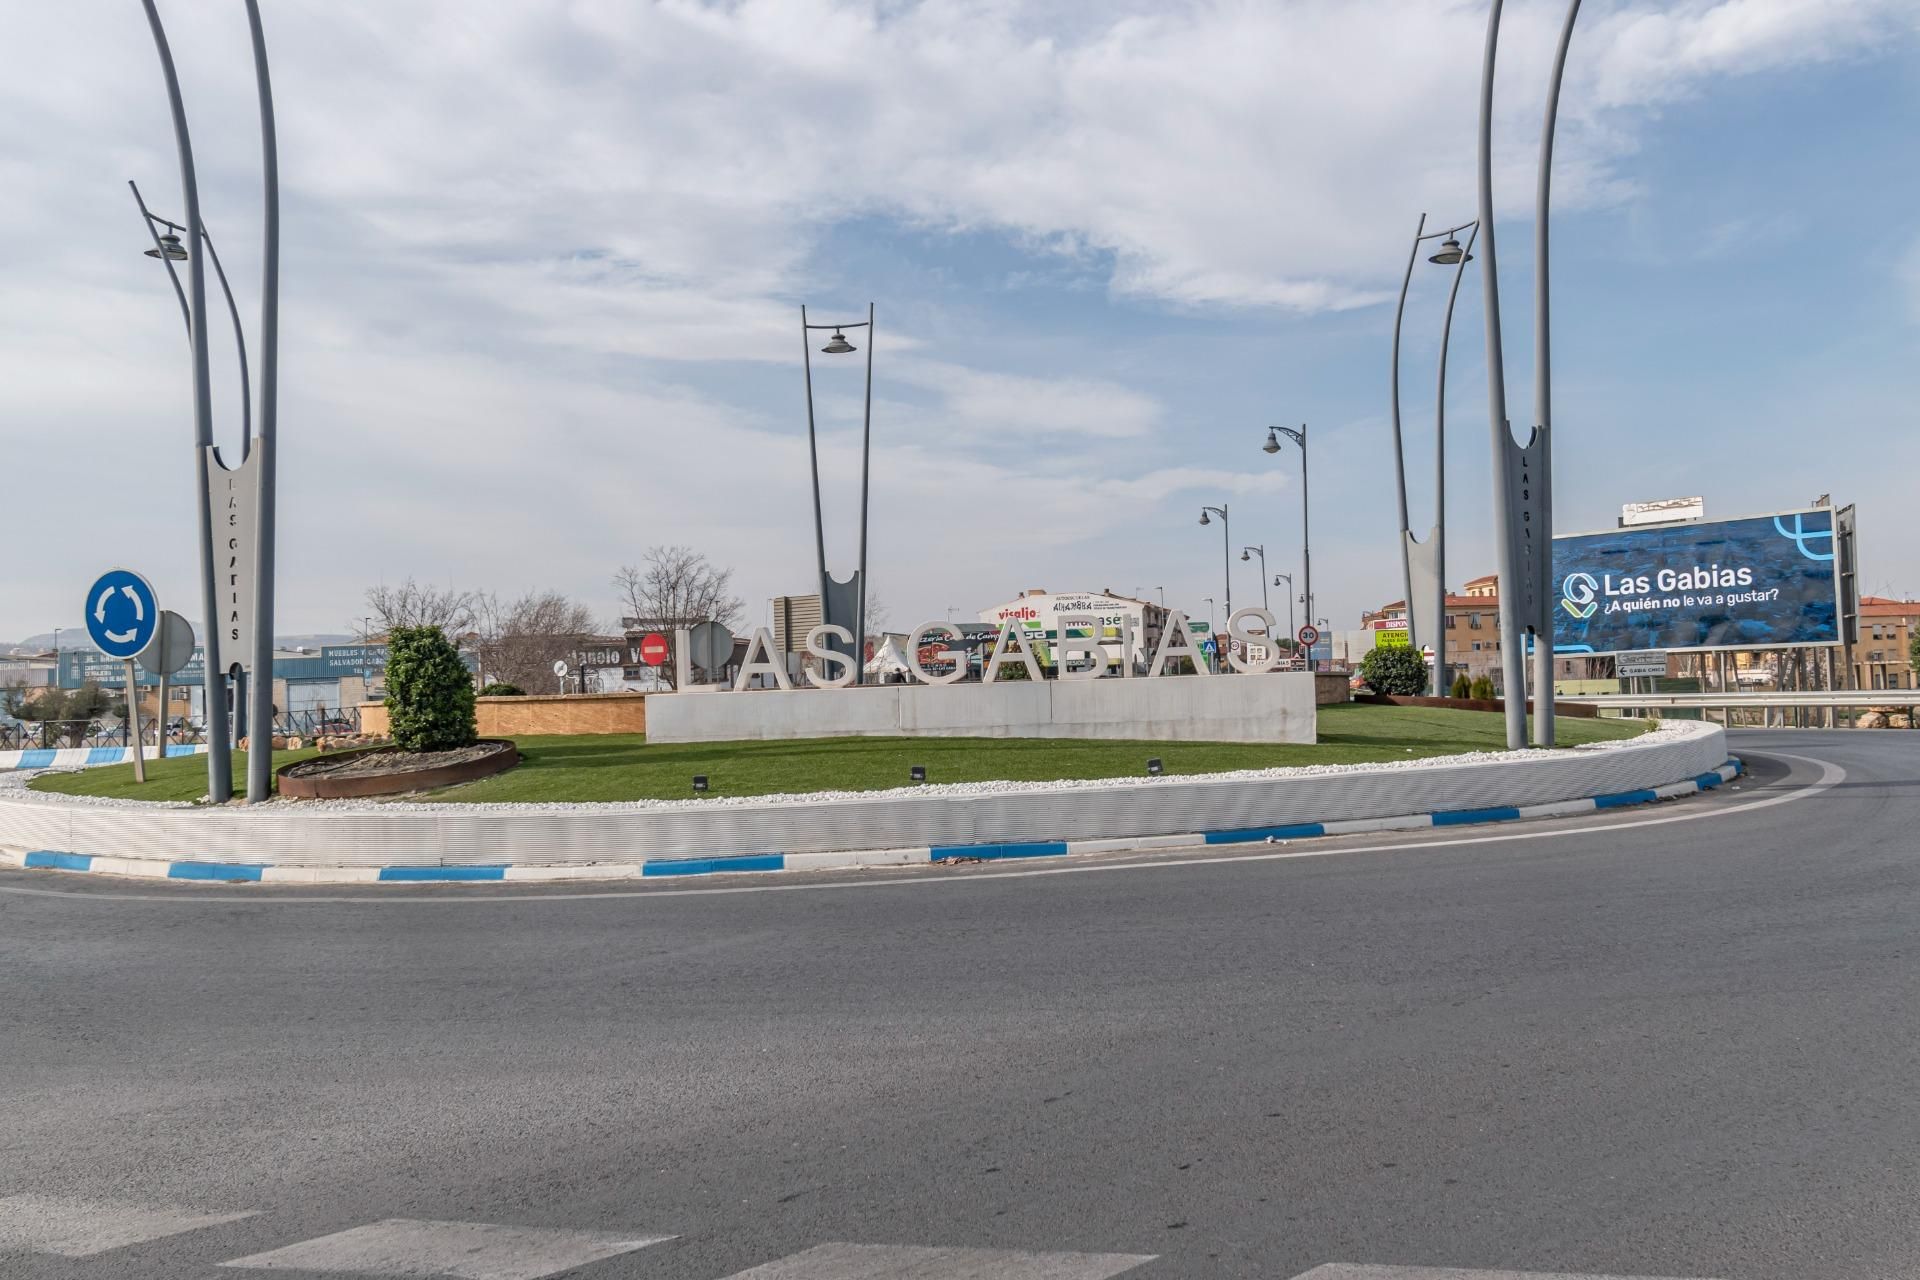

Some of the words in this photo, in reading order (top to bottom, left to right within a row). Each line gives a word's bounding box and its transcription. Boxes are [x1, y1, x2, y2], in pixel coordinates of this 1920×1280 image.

[1604, 574, 1650, 596] Las
[1657, 564, 1752, 592] Gabias
[1604, 601, 1621, 615] ¿A
[1622, 597, 1660, 613] quién
[1663, 598, 1681, 608] no
[1683, 595, 1694, 607] le
[1697, 596, 1712, 606] va
[1715, 595, 1724, 605] a
[1727, 588, 1779, 607] gustar?
[1385, 620, 1408, 629] DISPON
[977, 632, 1000, 641] Camp
[675, 624, 857, 693] LAS
[907, 607, 1280, 685] GABIAS
[329, 659, 363, 667] SALVADOR
